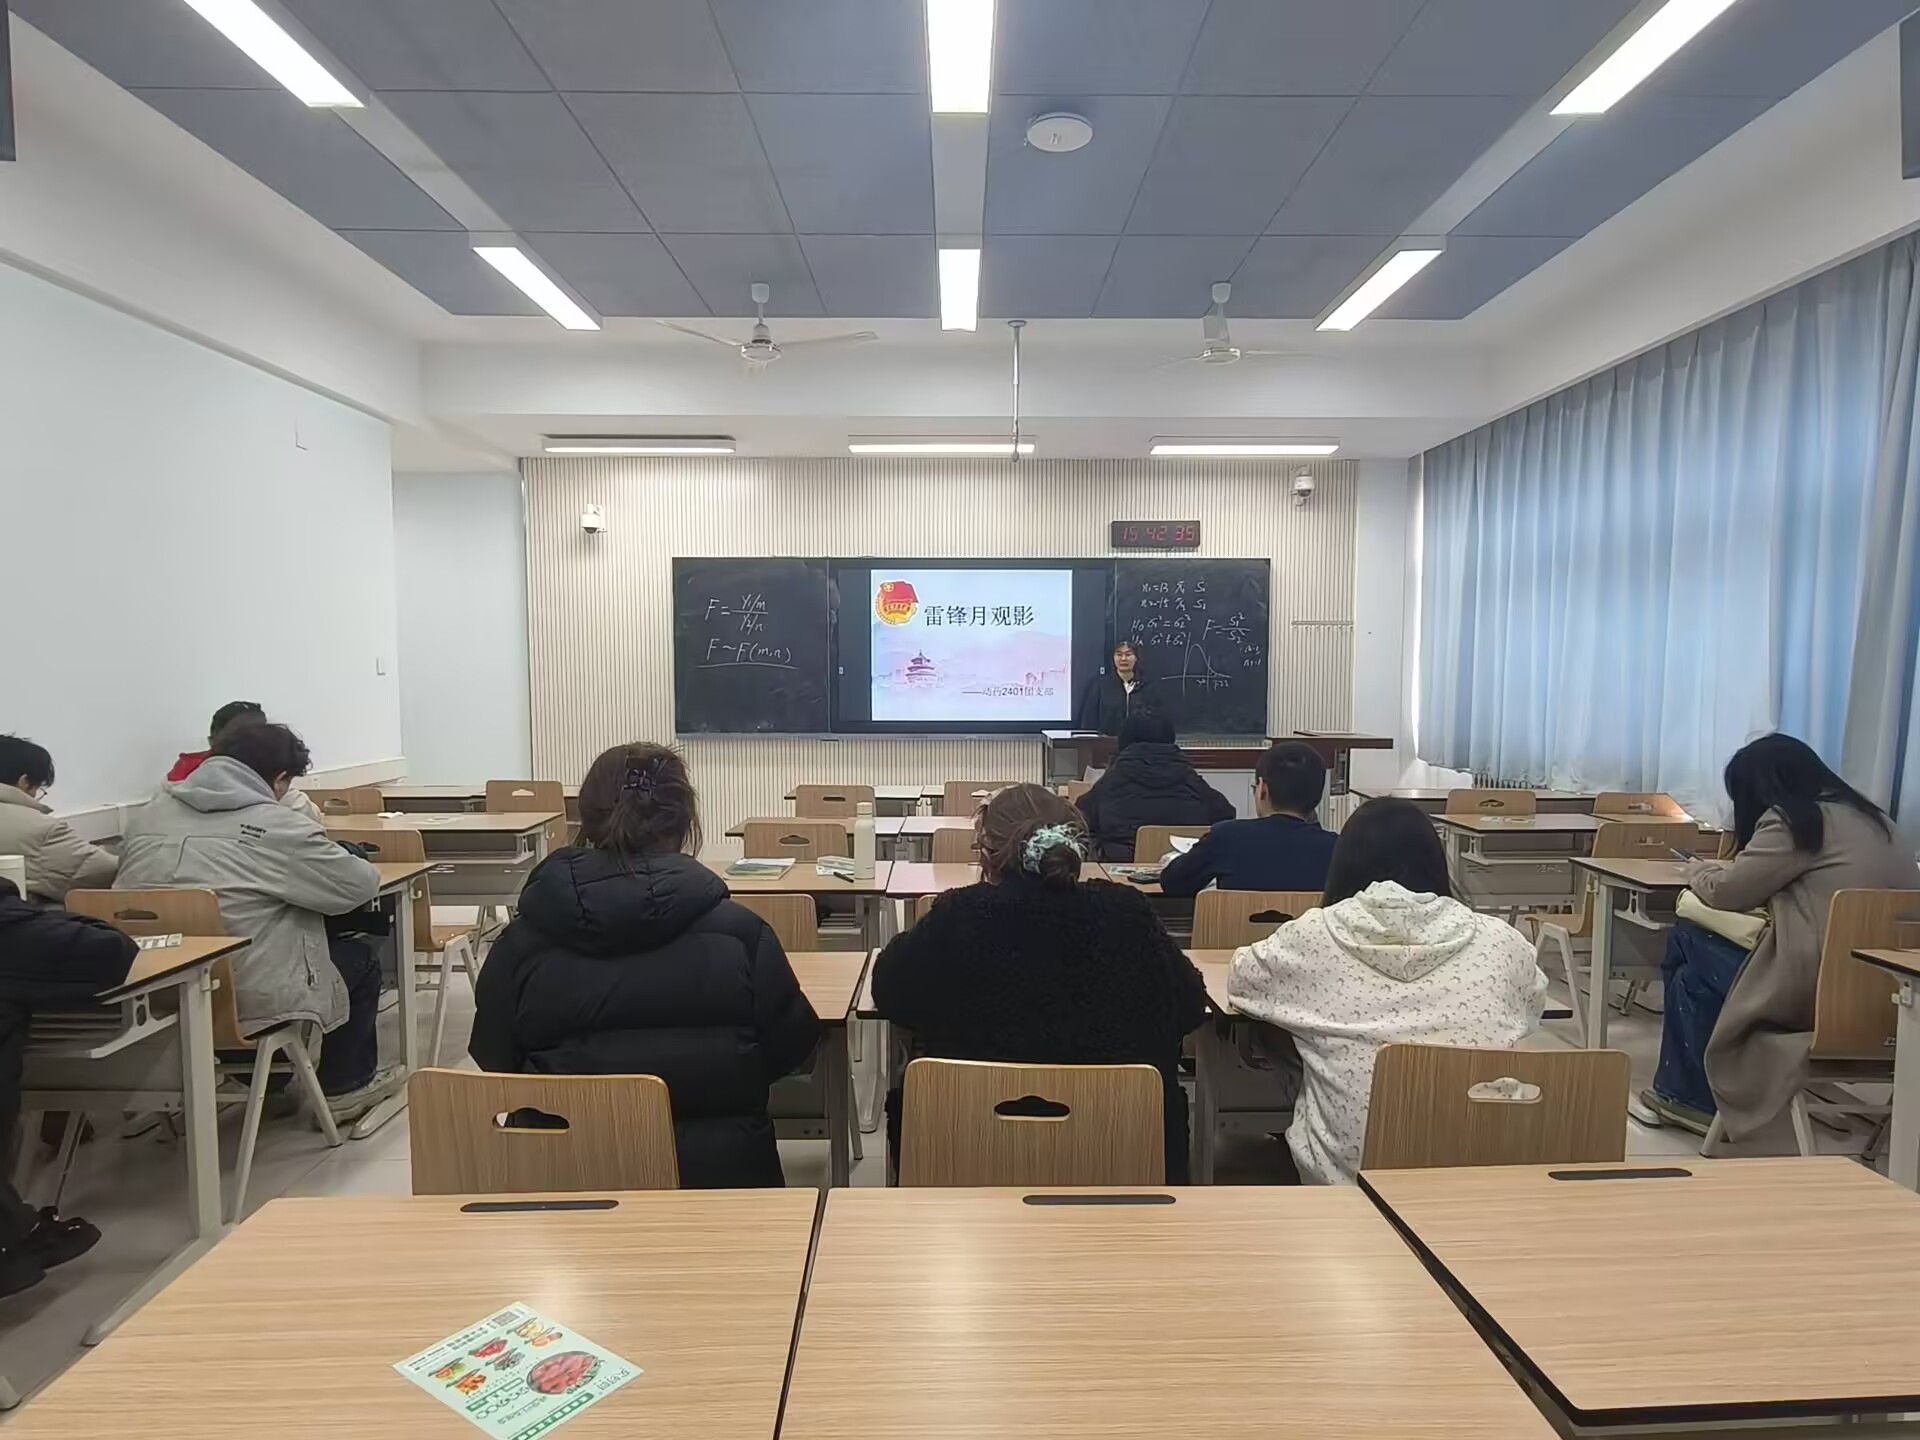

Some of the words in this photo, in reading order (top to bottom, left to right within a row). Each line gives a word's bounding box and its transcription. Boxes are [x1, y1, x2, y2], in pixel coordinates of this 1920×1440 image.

[924, 605, 1035, 627] 雷锋月观影
